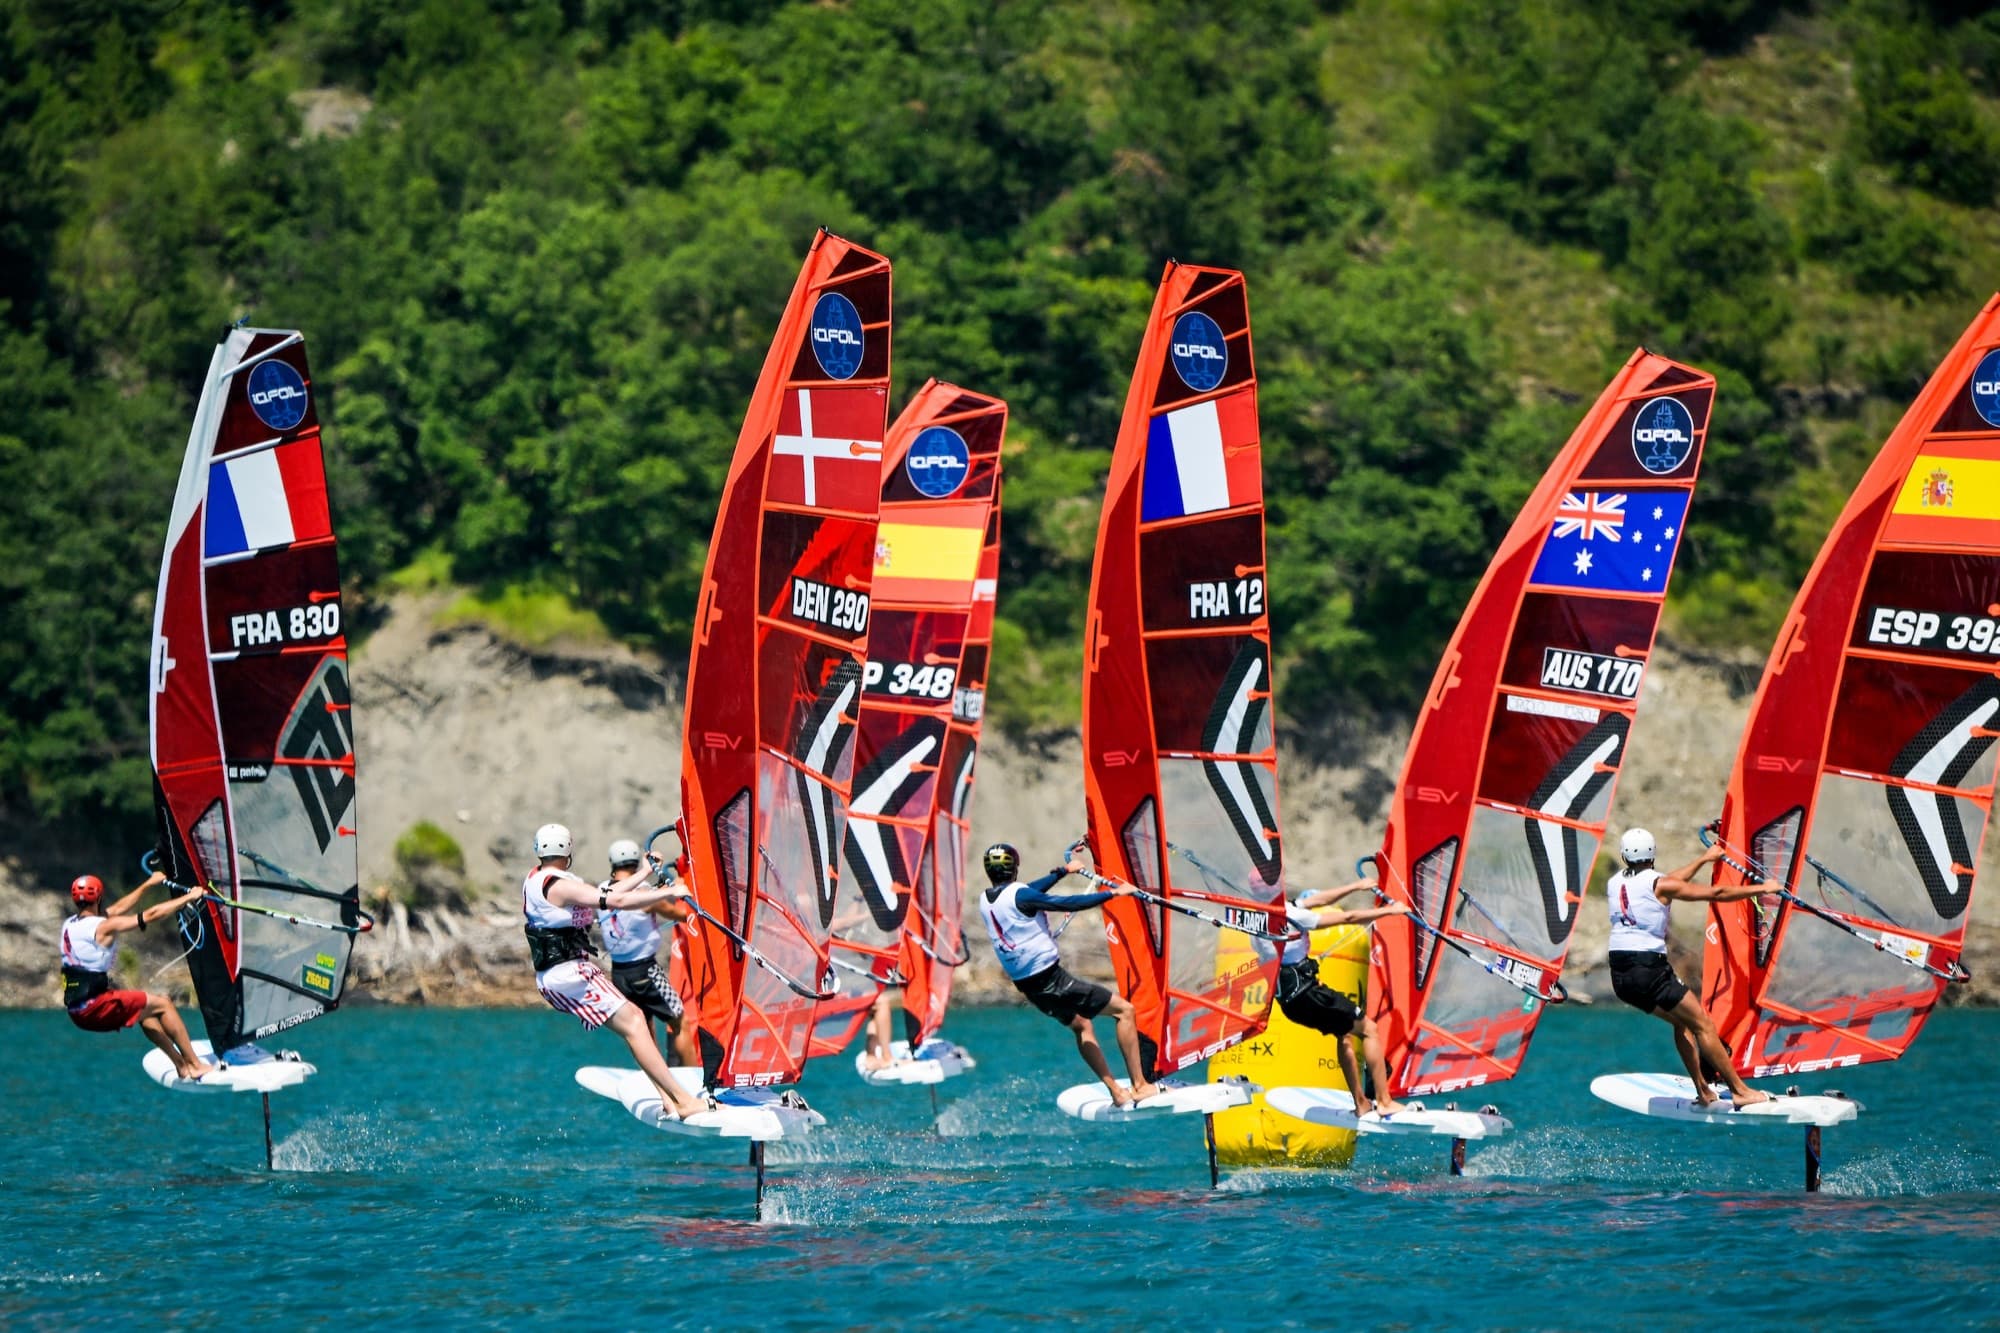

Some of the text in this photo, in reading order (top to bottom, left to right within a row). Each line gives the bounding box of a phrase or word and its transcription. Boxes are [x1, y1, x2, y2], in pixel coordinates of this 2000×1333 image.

[793, 578, 869, 632] DEN 290
[1190, 578, 1263, 619] FRA 12
[231, 603, 340, 648] FRA 830
[1868, 607, 1940, 646] ESP
[888, 663, 956, 699] 348
[1543, 651, 1643, 697] AUS 170
[1178, 1031, 1243, 1070] SEVERNE
[1753, 1053, 1862, 1078] SEVERNE
[734, 1071, 784, 1087] SEVERNE
[1407, 1073, 1488, 1097] SEVERNE
